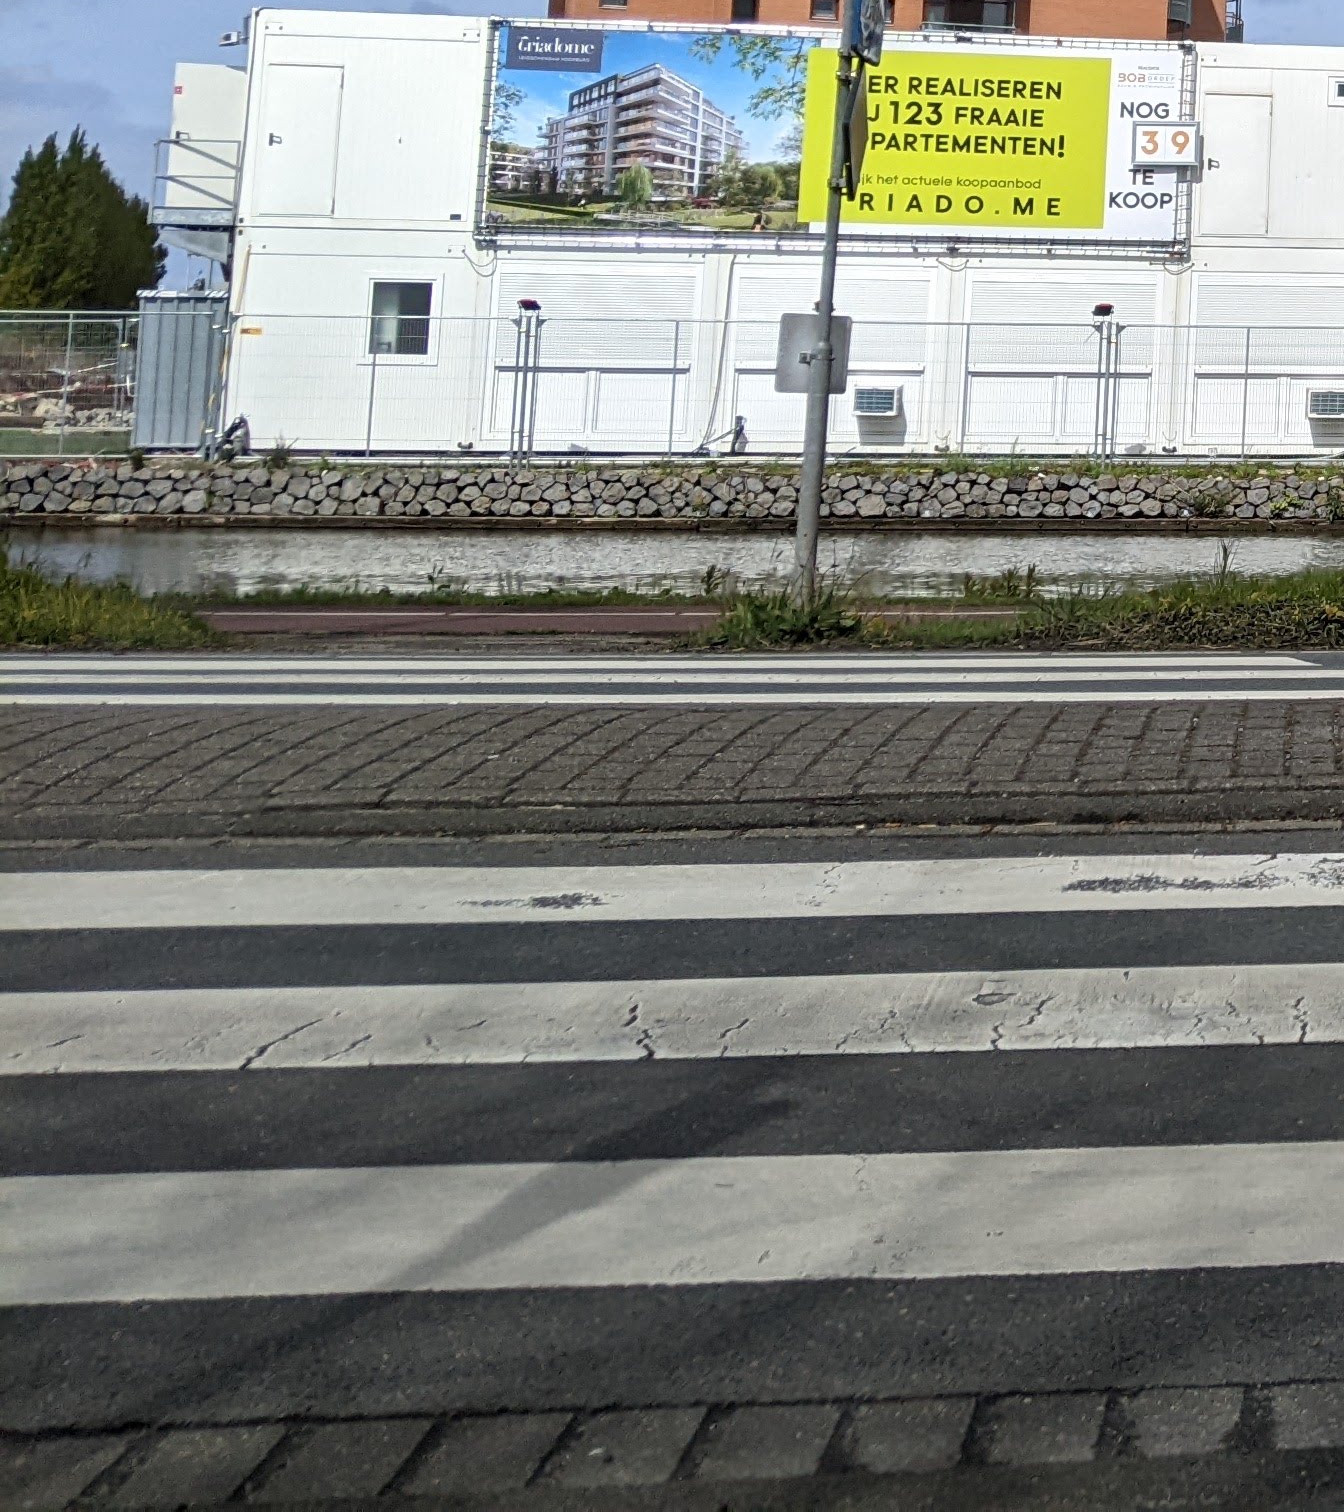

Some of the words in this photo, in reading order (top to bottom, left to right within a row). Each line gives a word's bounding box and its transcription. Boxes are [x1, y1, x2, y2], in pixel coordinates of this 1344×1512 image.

[1118, 72, 1146, 83] BOB
[868, 75, 898, 94] ER
[908, 76, 1062, 100] REALISEREN
[889, 100, 944, 126] 123
[954, 106, 1044, 128] FRAAIE
[1120, 101, 1170, 119] NOG
[870, 132, 1065, 158] PARTEMENTEN!
[877, 174, 898, 185] het
[902, 175, 952, 187] actuele
[956, 176, 1042, 190] koopaanbod
[1128, 169, 1155, 186] TE
[1109, 191, 1173, 209] KOOP
